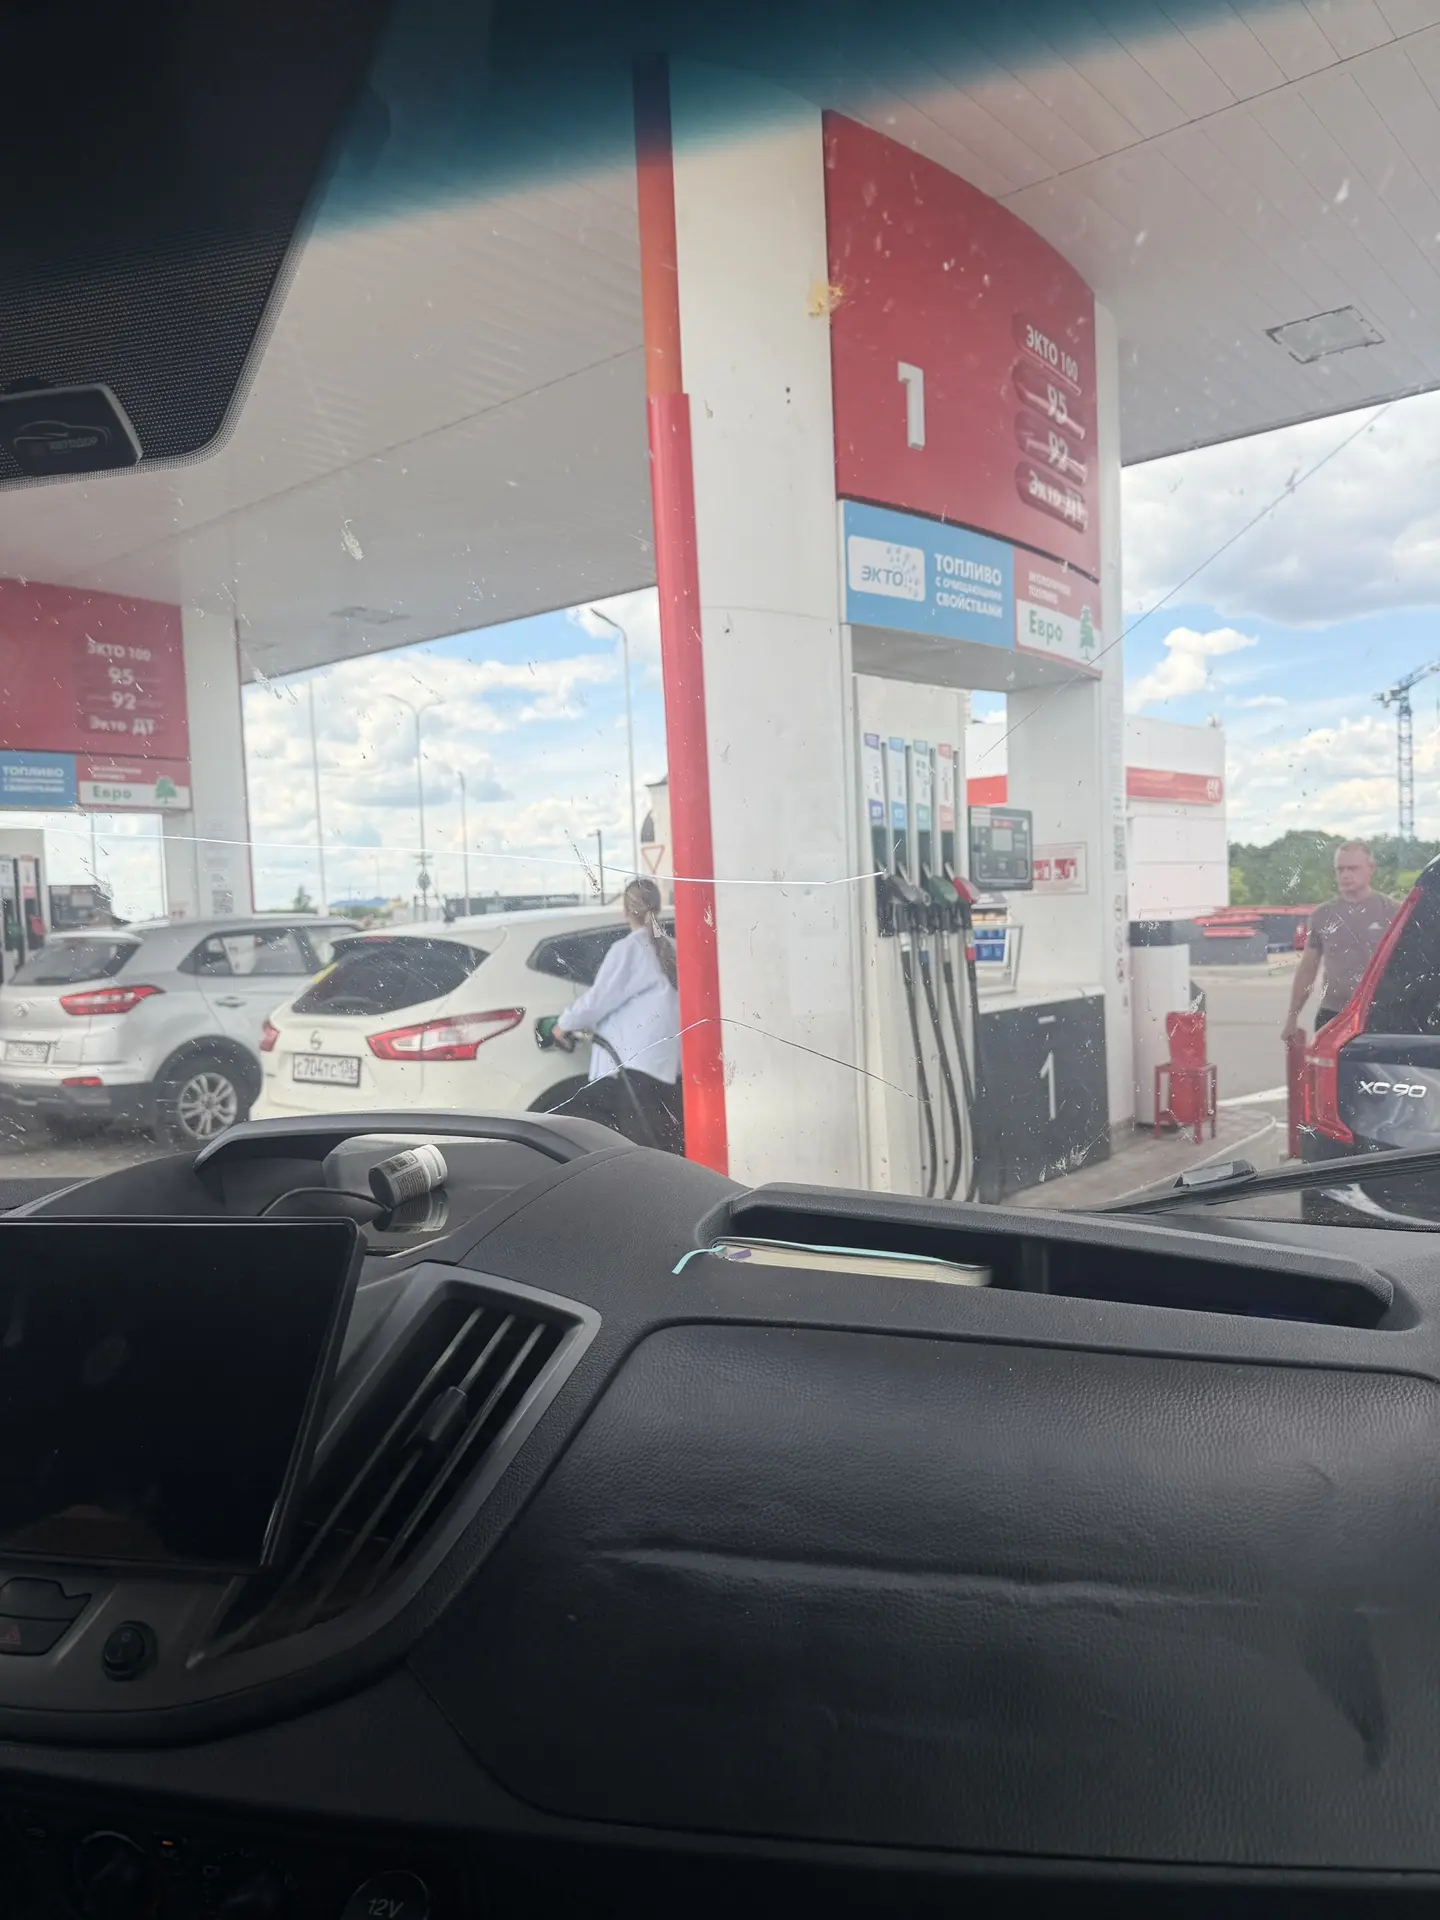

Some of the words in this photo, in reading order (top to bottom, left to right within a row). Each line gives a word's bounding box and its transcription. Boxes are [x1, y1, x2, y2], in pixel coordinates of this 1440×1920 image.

[1025, 323, 1058, 366] ЭКТО
[1060, 350, 1079, 383] 100
[897, 360, 926, 452] 1
[1046, 383, 1068, 424] 95
[1048, 430, 1069, 471] 92
[860, 565, 904, 587] ЭКТО
[933, 552, 1003, 586] ТОПЛИВО
[935, 591, 1003, 619] СВОЙСТВАМИ
[1028, 610, 1063, 645] Евро
[87, 641, 126, 659] ЭКТО
[129, 646, 152, 662] 100
[108, 666, 134, 686] 95
[111, 690, 136, 710] 92
[1, 765, 65, 778] ТОПЛИВО
[92, 784, 132, 801] Евро
[1039, 1050, 1056, 1120] 1
[367, 1897, 404, 1919] 12V
